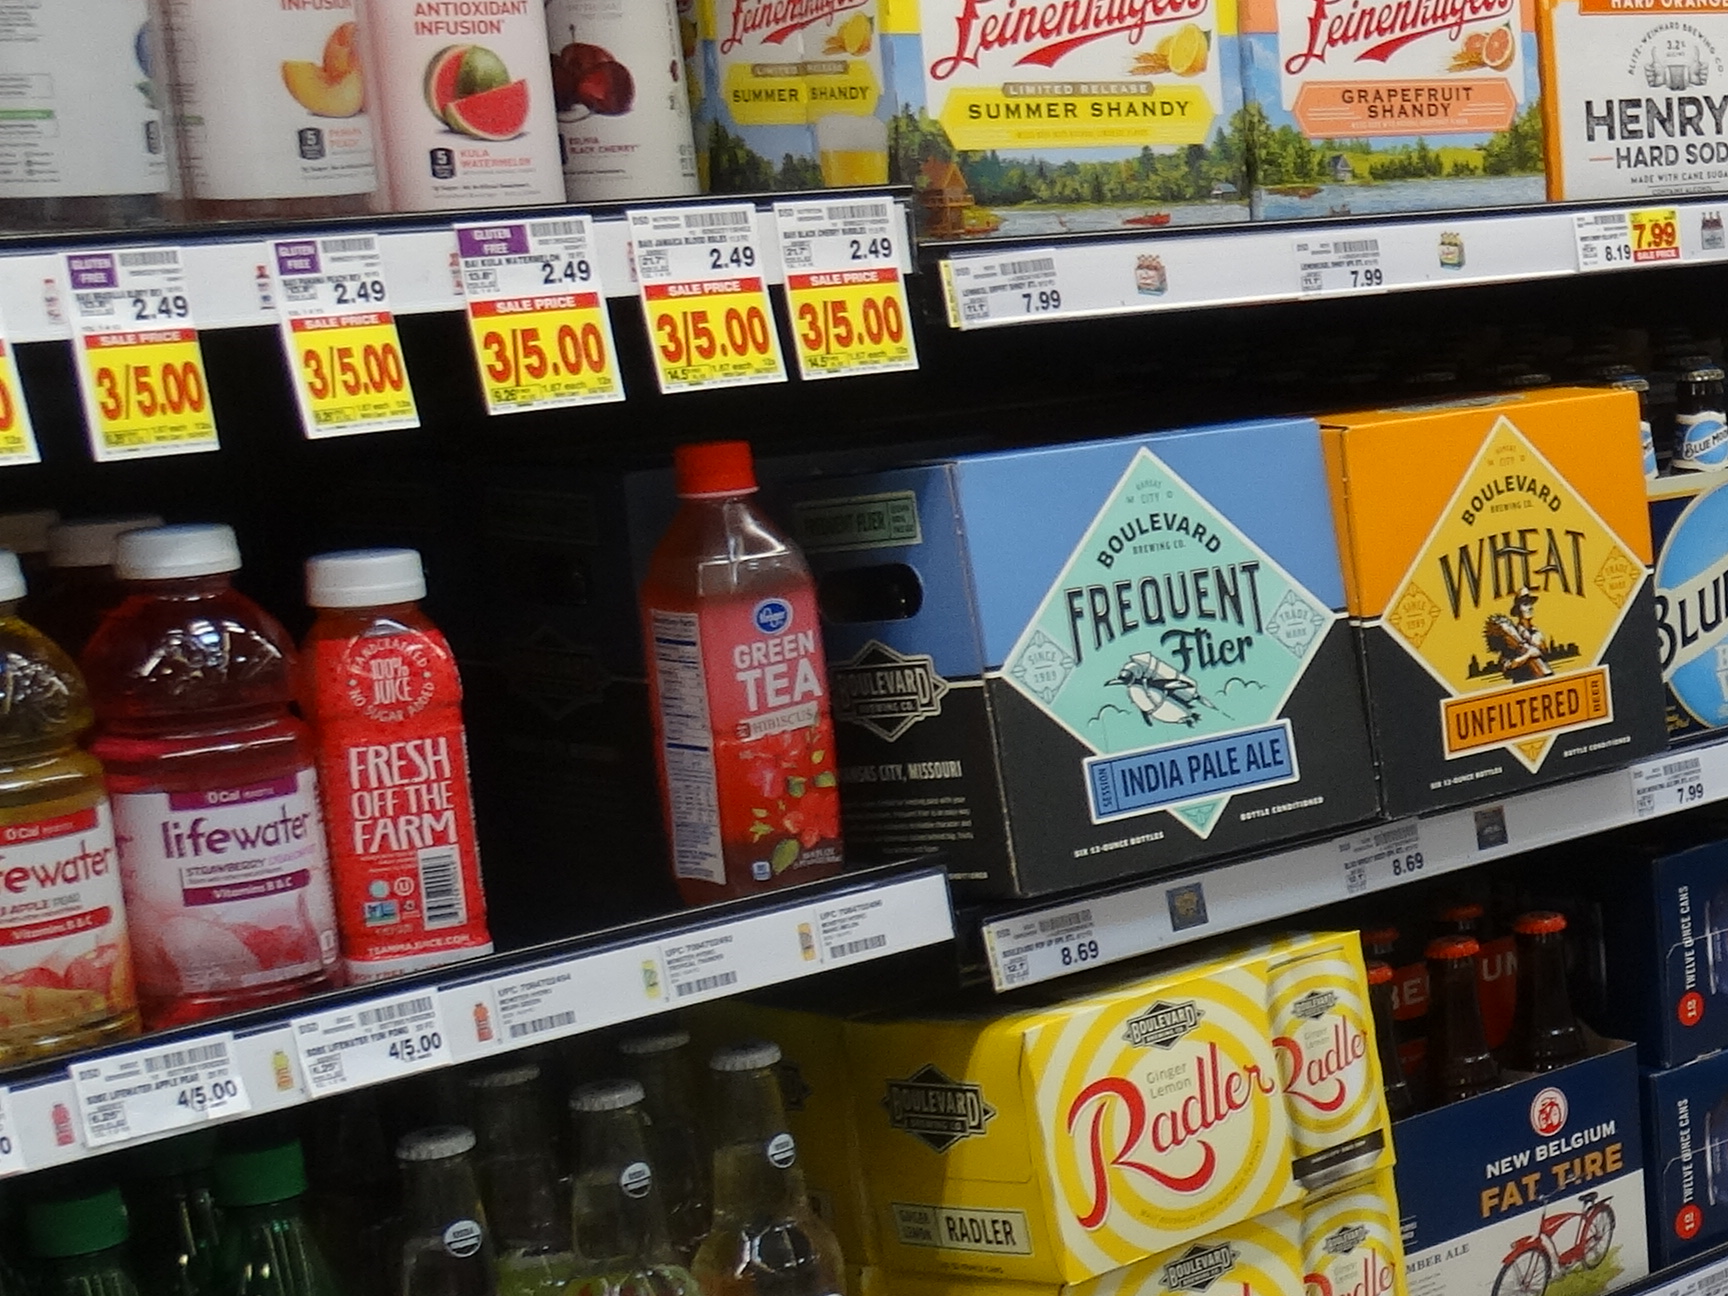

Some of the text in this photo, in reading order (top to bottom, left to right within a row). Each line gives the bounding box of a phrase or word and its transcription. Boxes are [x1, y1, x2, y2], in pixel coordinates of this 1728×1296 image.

[413, 0, 529, 18] ANTIOXIDANT
[413, 18, 506, 35] INFUSION
[967, 99, 1191, 120] SUMMER SHANDY
[1002, 83, 1152, 96] LIMITED RELEASE
[1341, 88, 1474, 104] GRAPEFRUIT
[1367, 103, 1454, 119] SHANDY
[1614, 143, 1681, 169] HARD
[541, 260, 593, 285] 2.49
[494, 297, 578, 313] SALE PRICE
[1021, 290, 1062, 313] 7.99
[481, 324, 606, 385] 3/5.00
[98, 365, 201, 422] 3/5.00
[1096, 513, 1223, 568] BOULEVARD
[1440, 528, 1587, 621] WHEAT
[1065, 561, 1264, 666] FREQUENT
[732, 630, 815, 670] GREEN
[1161, 630, 1254, 678] Flier
[735, 668, 822, 711] TEA
[751, 706, 815, 734] HIBISCUS
[1455, 694, 1581, 740] UNFILTERED
[348, 739, 451, 789] FRESH
[1120, 741, 1286, 798] INDIA PALE ALE
[351, 784, 455, 820] OFF THE
[161, 808, 310, 860] lifewater
[354, 812, 458, 854] FARM
[1060, 942, 1100, 964] 8.69
[388, 1031, 444, 1063] 4/5.00
[1066, 1040, 1273, 1230] Radler
[1485, 1120, 1617, 1179] NEW BELGIUM
[1677, 1098, 1695, 1204] TWELVE OUNCE CANS
[1480, 1144, 1624, 1218] FAT TIRE
[945, 1215, 1017, 1248] RADLER
